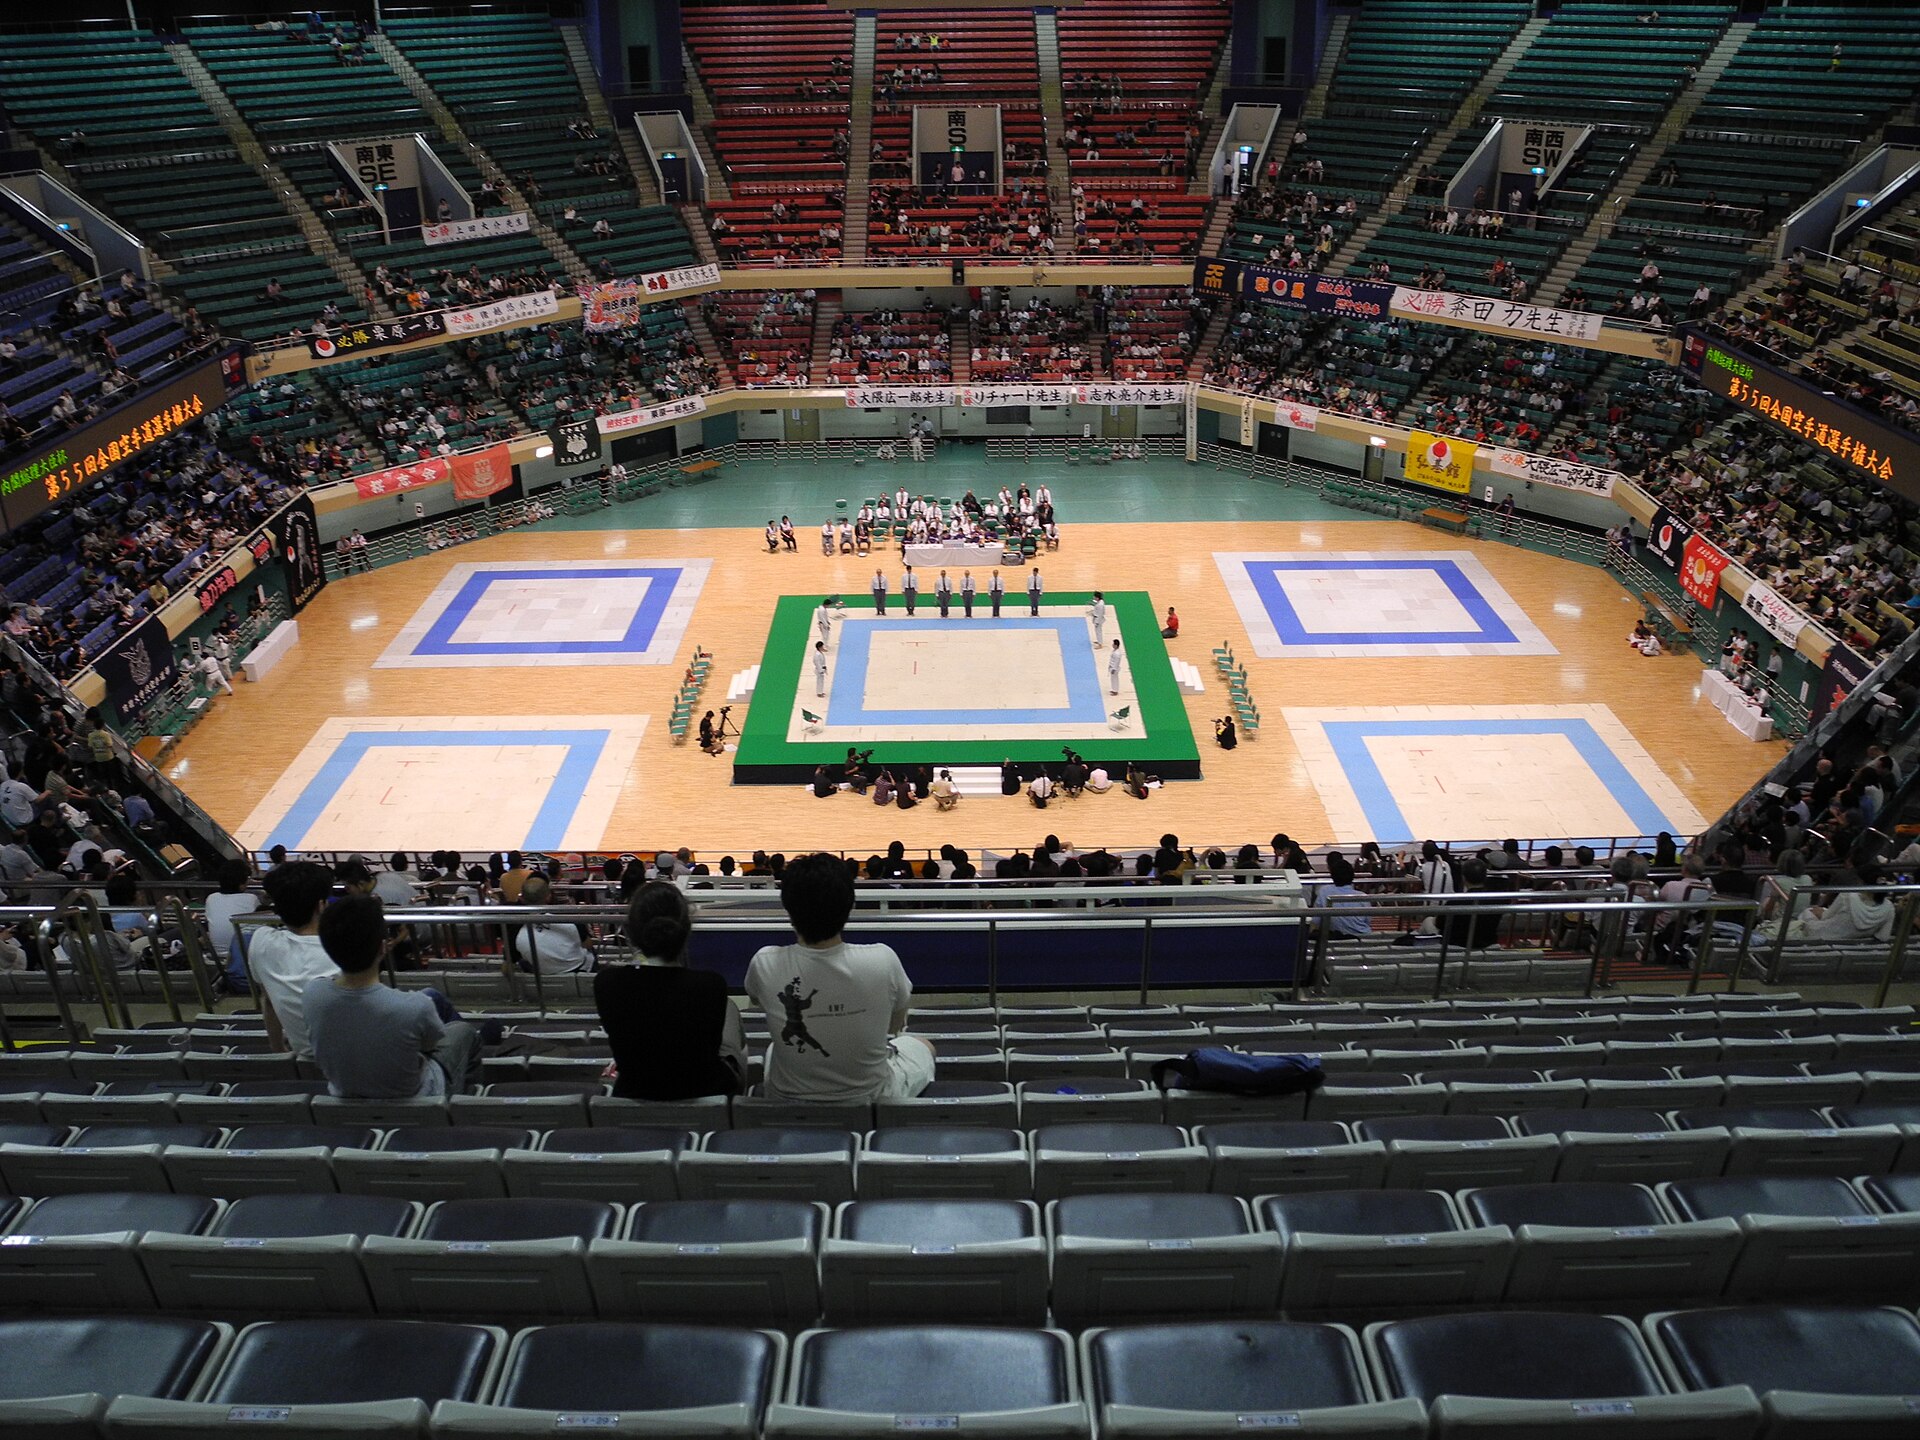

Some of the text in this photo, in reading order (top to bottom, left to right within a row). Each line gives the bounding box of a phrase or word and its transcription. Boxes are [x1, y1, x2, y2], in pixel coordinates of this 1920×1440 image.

[947, 110, 966, 127] 南
[948, 127, 967, 145] S
[1524, 128, 1565, 148] 南西
[355, 144, 394, 164] 南東
[1522, 147, 1562, 167] SW
[358, 163, 397, 183] SE
[1402, 292, 1446, 315] 必勝
[336, 329, 371, 348] 必勝
[859, 389, 947, 404] 大隈広一郎先生
[974, 388, 1063, 403] リチャード先生
[1090, 388, 1177, 402] 志水亮介先生
[1416, 454, 1461, 479] 弘基館
